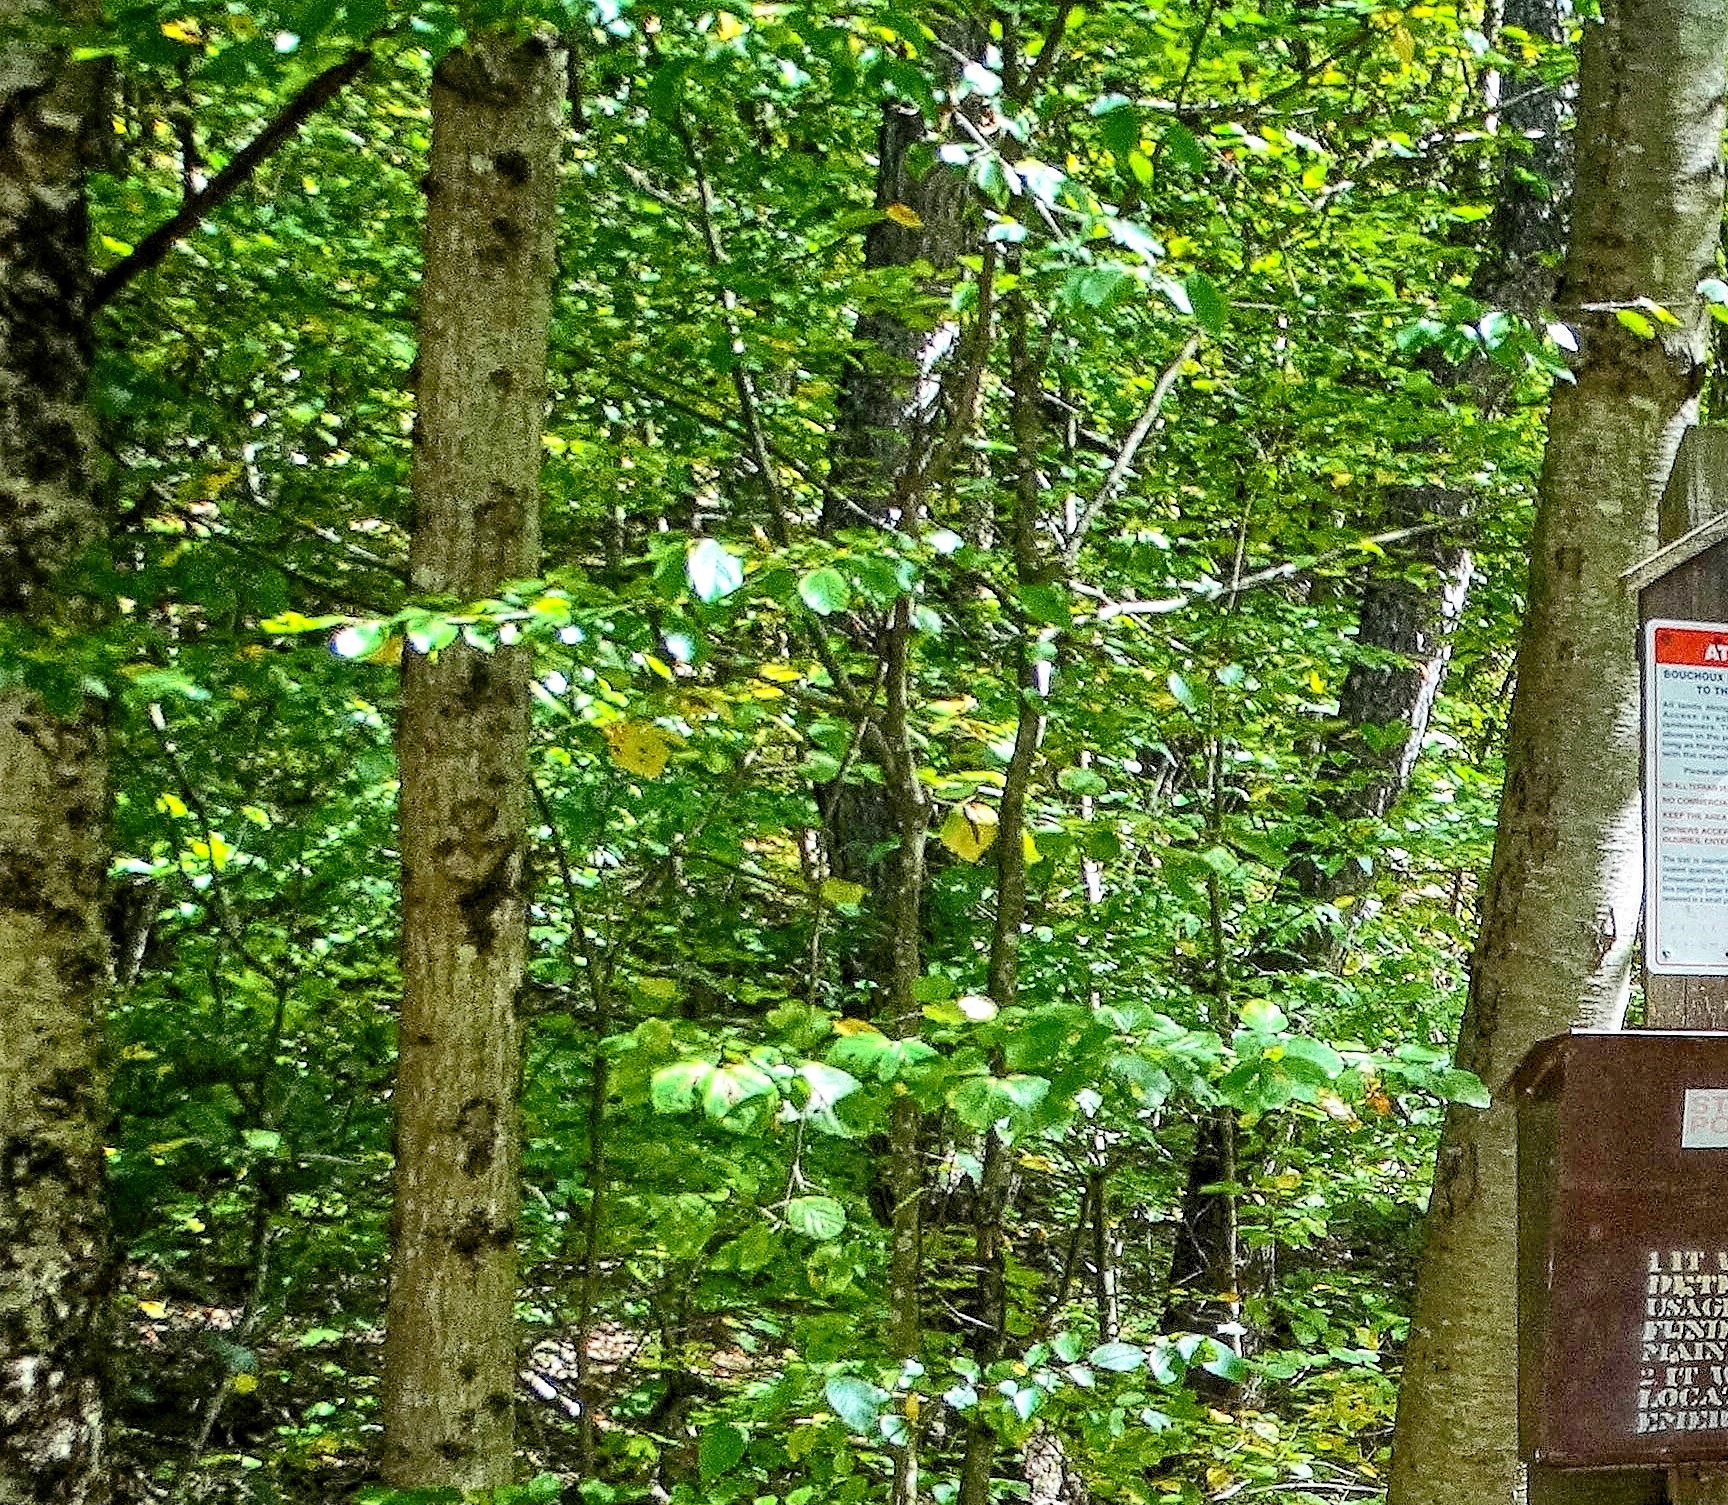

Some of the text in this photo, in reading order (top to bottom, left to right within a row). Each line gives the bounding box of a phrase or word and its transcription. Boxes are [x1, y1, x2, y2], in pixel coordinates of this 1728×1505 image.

[1696, 685, 1711, 694] TO
[1668, 1250, 1706, 1272] IT
[1666, 1365, 1699, 1388] IT
